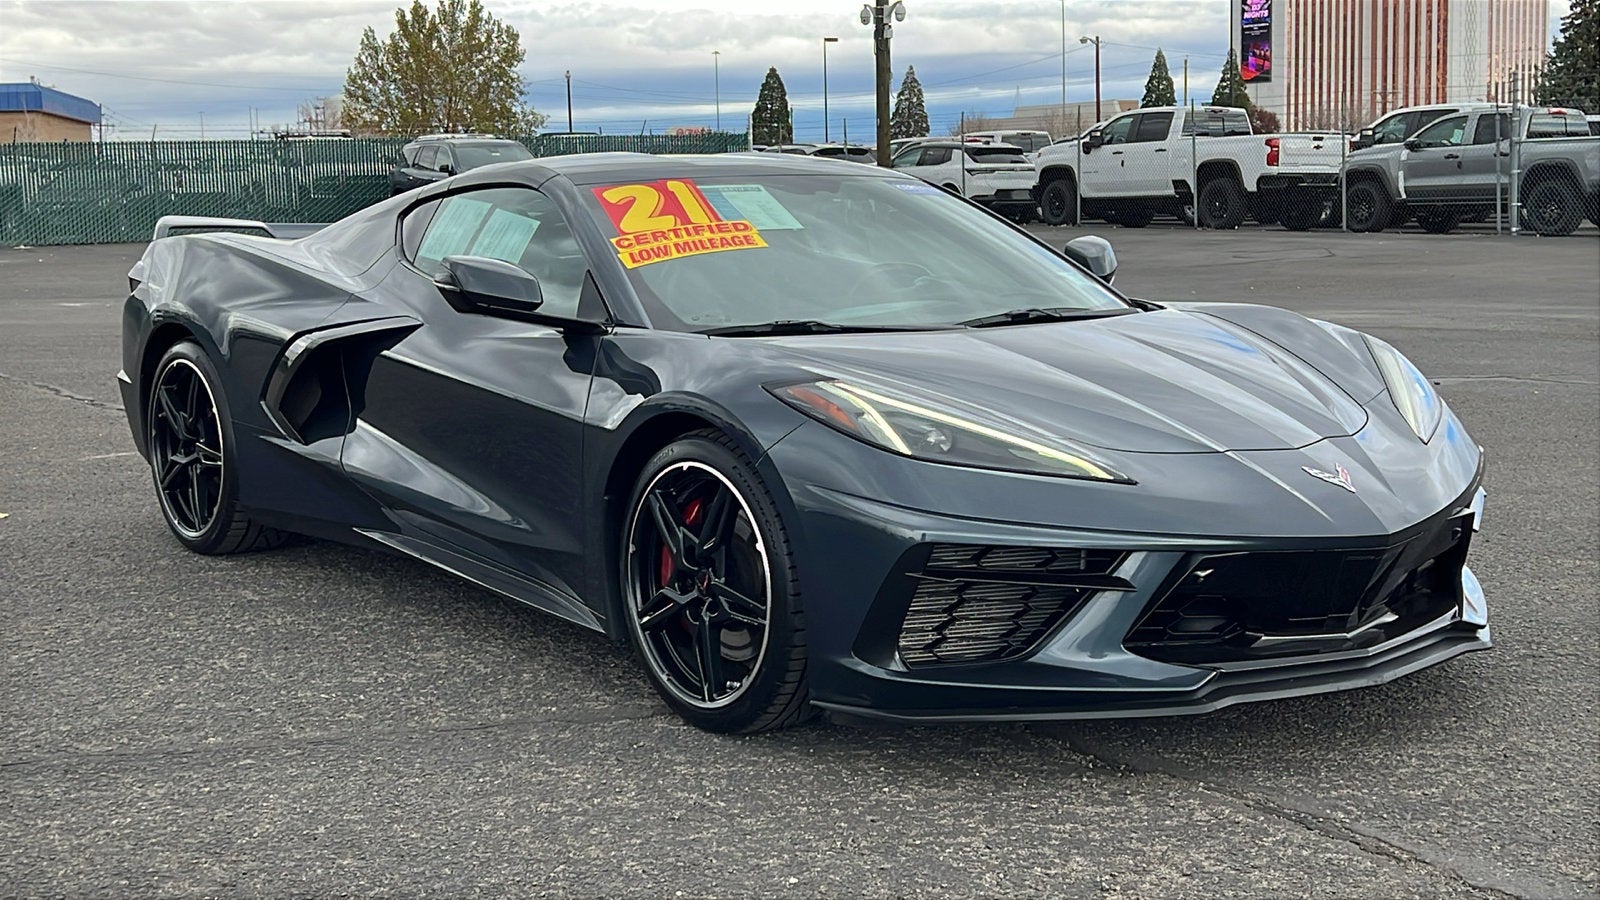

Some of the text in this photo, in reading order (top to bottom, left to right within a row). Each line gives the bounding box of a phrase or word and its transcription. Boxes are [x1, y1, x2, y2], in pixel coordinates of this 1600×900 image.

[1243, 10, 1269, 19] NIGHTS
[602, 180, 712, 232] 21
[615, 221, 752, 249] CERTIFIED
[629, 234, 757, 264] LOW MILEAGE
